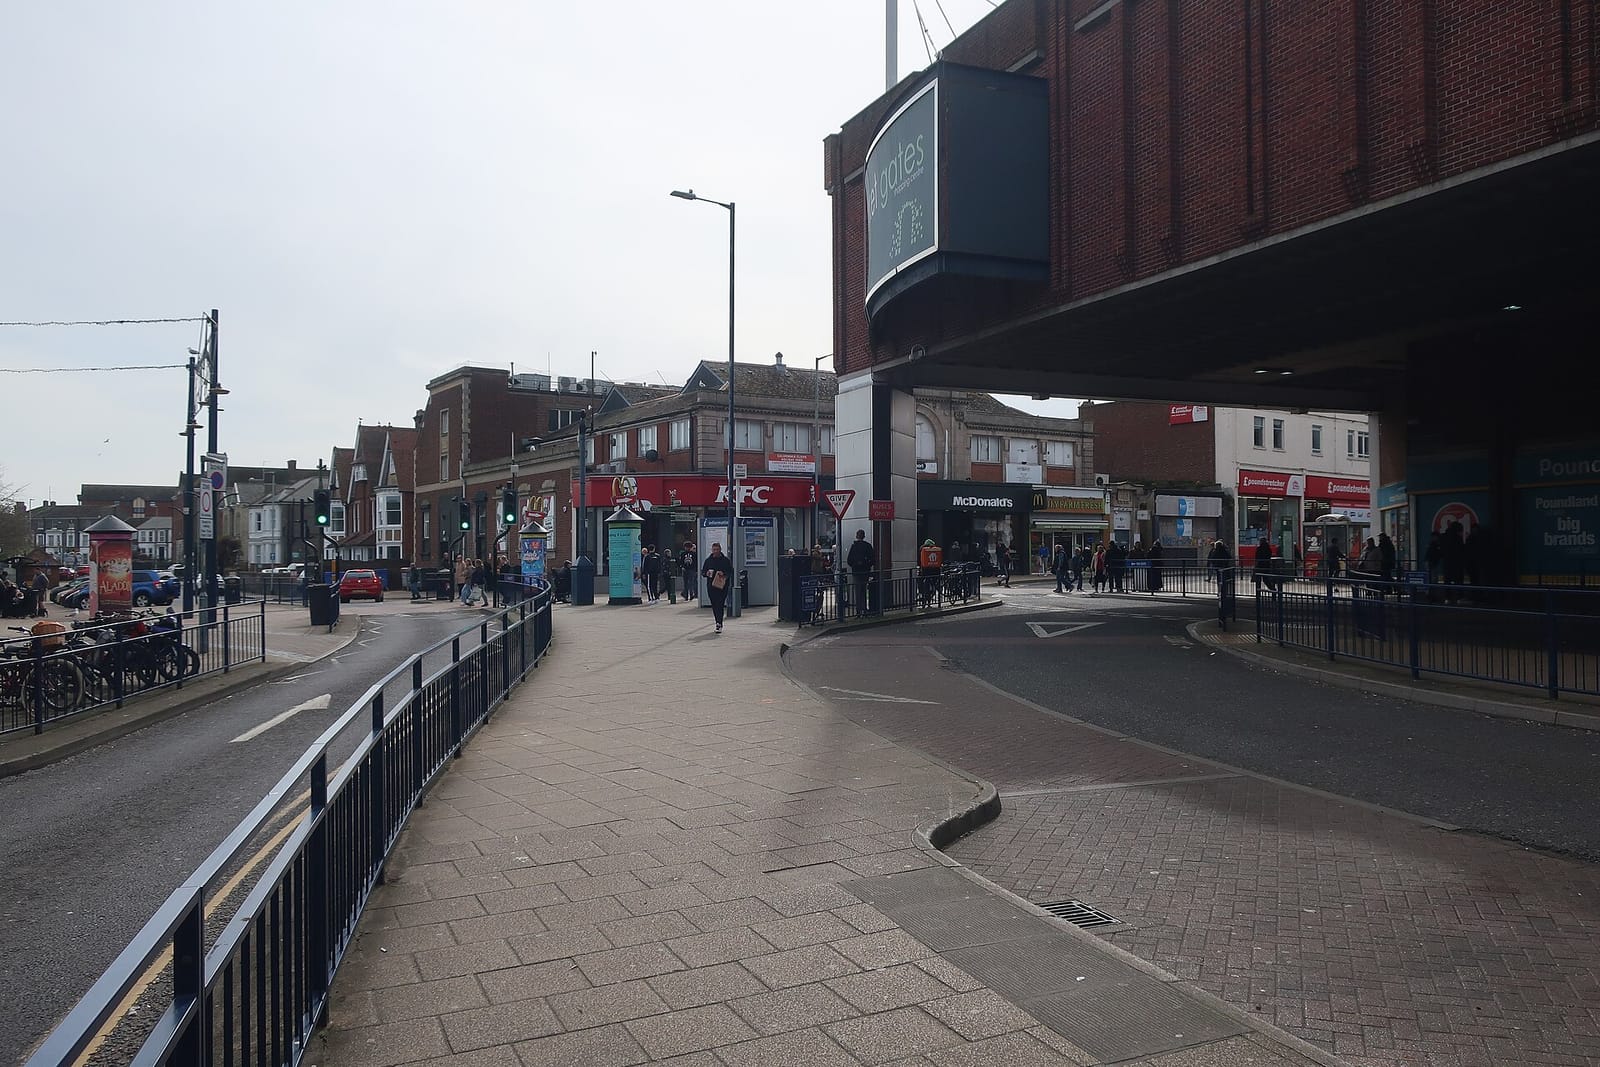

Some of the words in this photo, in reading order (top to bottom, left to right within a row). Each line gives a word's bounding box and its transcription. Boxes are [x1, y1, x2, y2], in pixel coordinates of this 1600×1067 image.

[880, 134, 924, 209] gates
[714, 485, 770, 504] KFC
[829, 494, 847, 502] GIVE
[952, 496, 1013, 508] McDonald's
[1535, 494, 1599, 509] Poundland
[1557, 516, 1580, 534] big
[1544, 531, 1596, 546] brands
